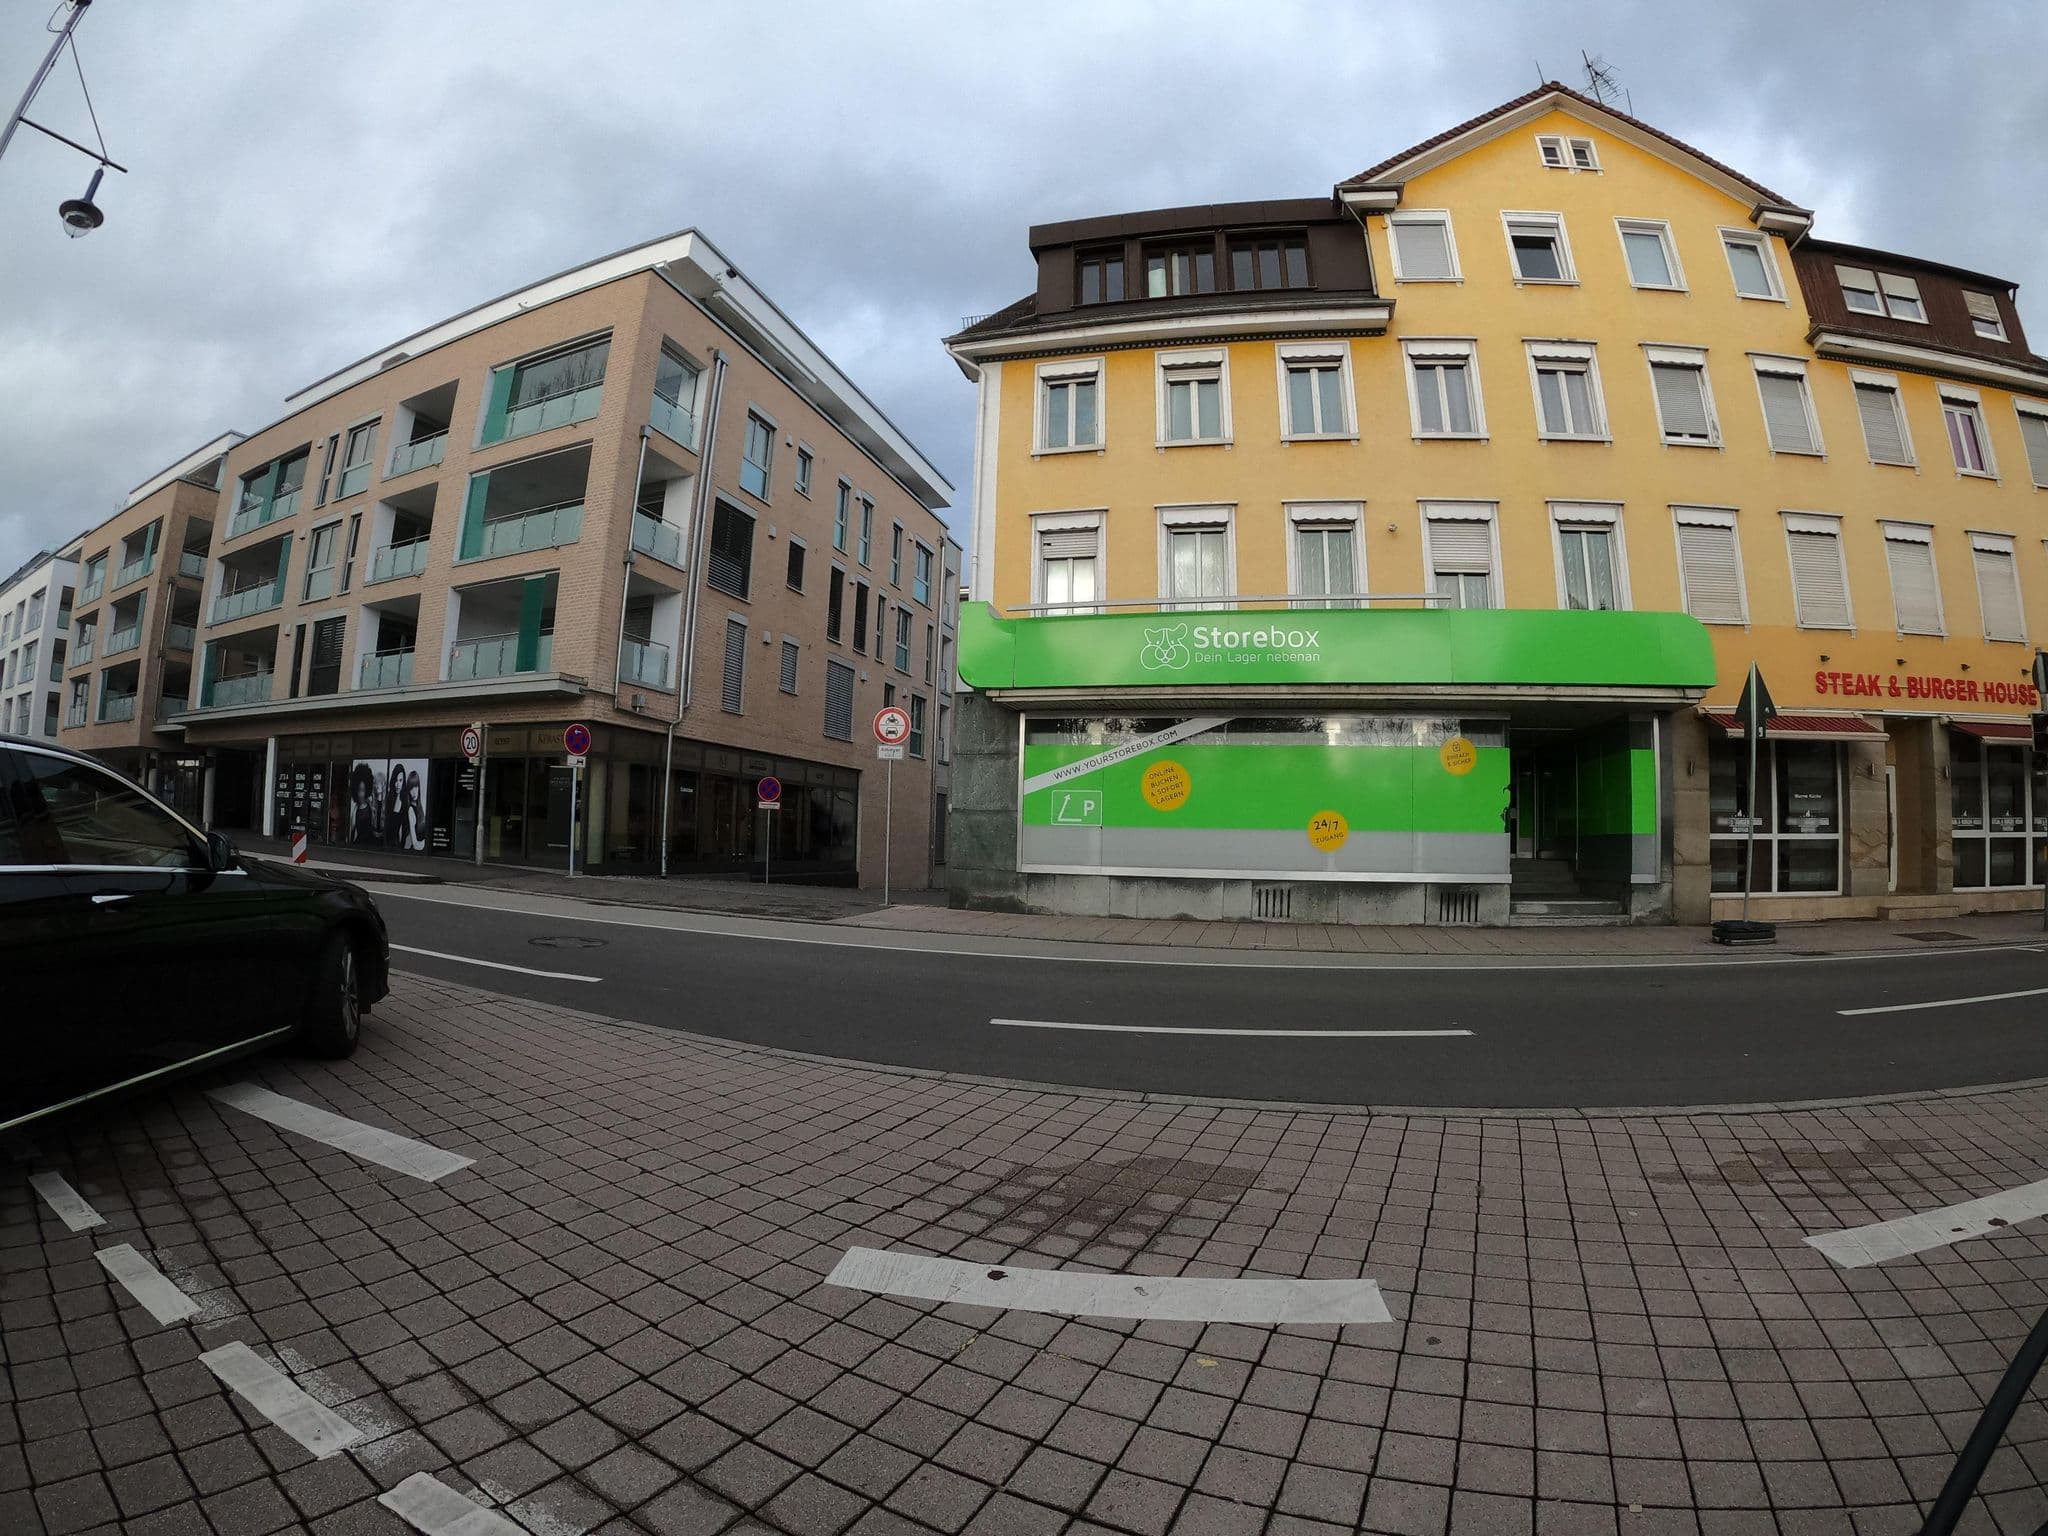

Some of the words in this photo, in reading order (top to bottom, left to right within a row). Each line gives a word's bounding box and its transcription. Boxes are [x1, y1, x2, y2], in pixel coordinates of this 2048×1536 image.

[1193, 625, 1320, 648] Storebox
[1195, 652, 1222, 663] Dein
[1227, 652, 1262, 665] Lager
[1266, 652, 1320, 663] nebenan
[1815, 671, 1882, 696] STEAK
[1888, 675, 1901, 697] &
[1906, 676, 1979, 702] BURGER
[1983, 681, 2038, 706] HOUSE
[466, 736, 476, 750] 20
[1053, 730, 1179, 780] WWW.YOURSTOREBOX.COM
[1149, 767, 1174, 779] ONLINE
[1083, 799, 1096, 817] P
[1314, 819, 1339, 832] 24/7
